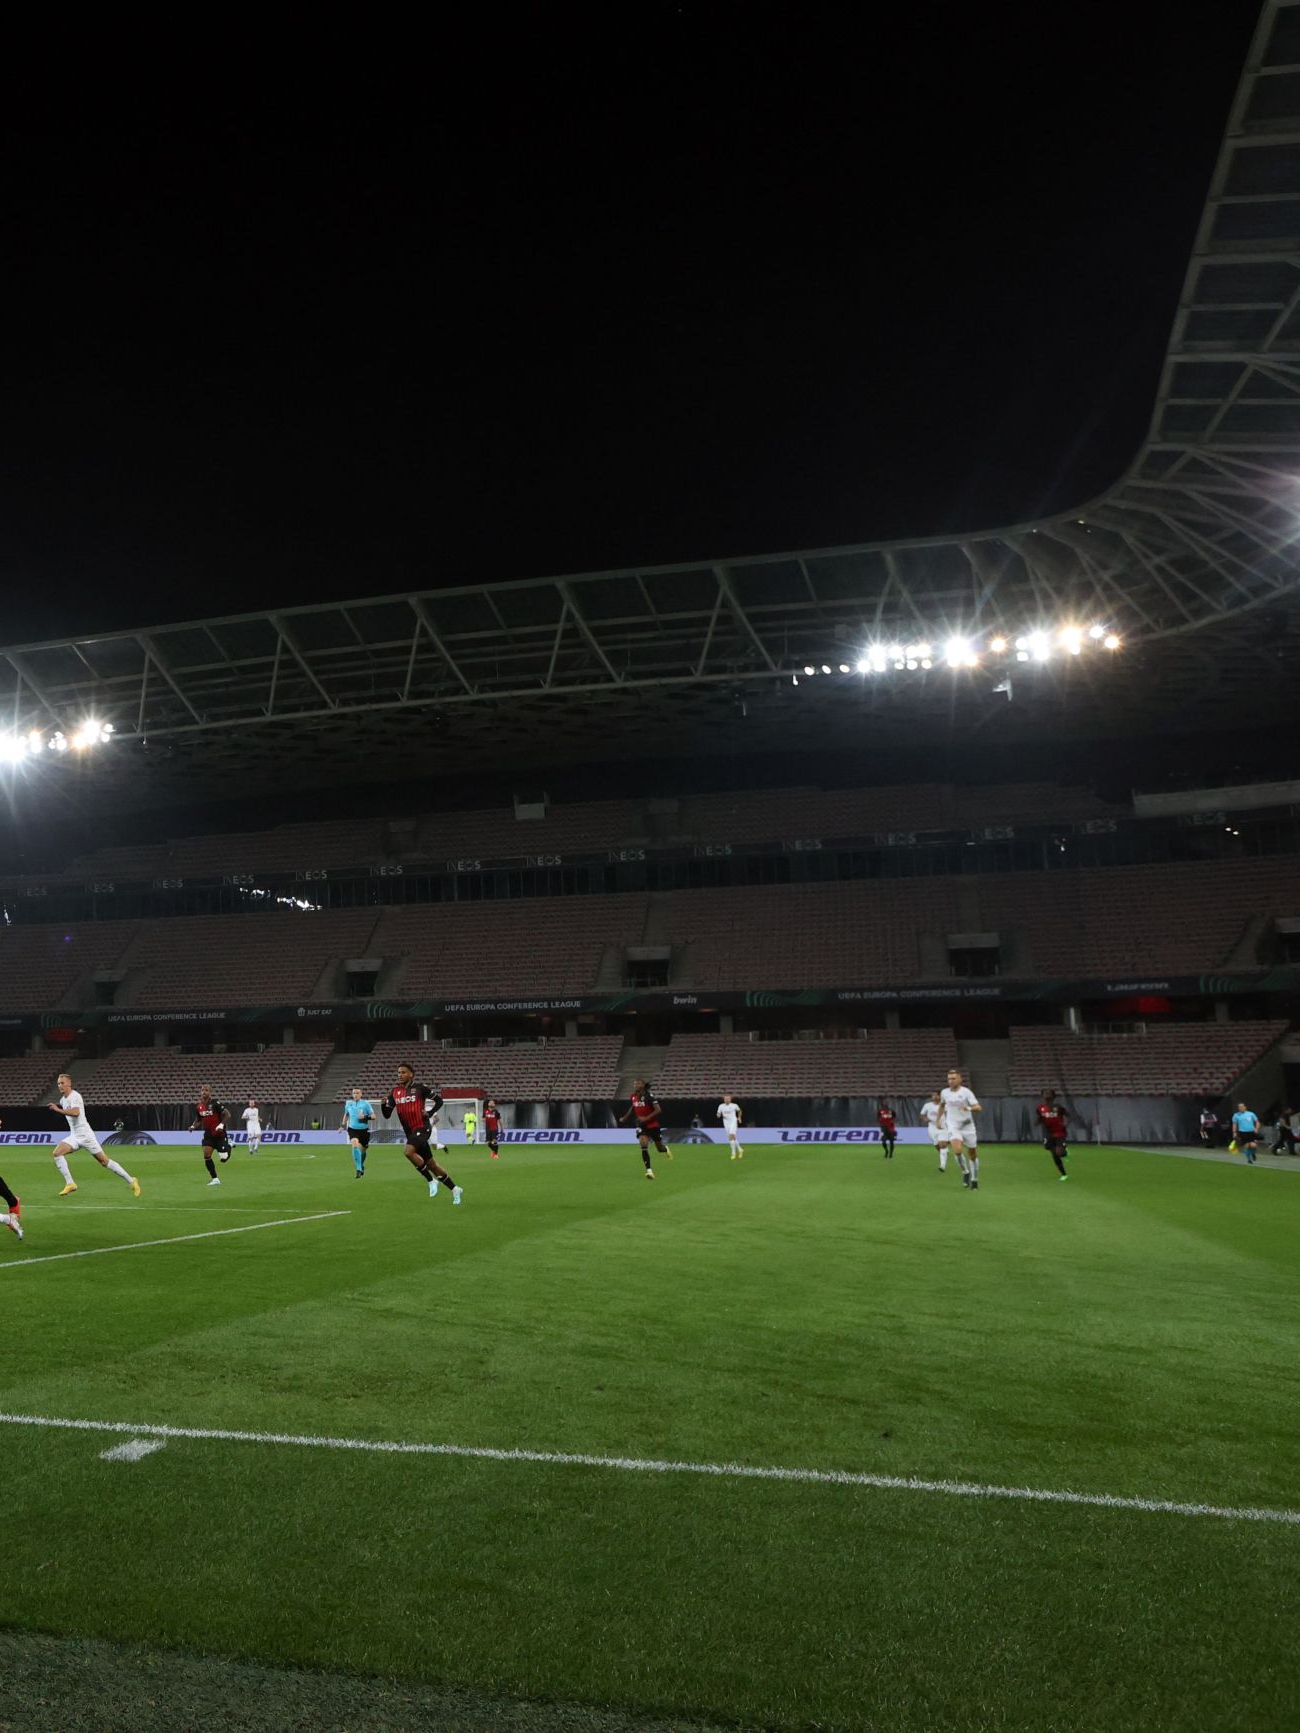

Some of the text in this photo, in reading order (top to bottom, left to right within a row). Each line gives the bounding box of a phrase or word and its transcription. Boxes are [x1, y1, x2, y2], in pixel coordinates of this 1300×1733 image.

[837, 987, 1000, 1000] UEFA EUROPA CONFERENCE LEAGUE
[467, 1003, 496, 1011] EUROPA
[497, 1001, 548, 1010] CONFERENCE
[551, 1000, 581, 1008] LEAGUE
[673, 995, 698, 1005] bwin
[107, 1014, 125, 1022] UEFA
[153, 1012, 197, 1021] CONFERENCE
[199, 1011, 226, 1019] LEAGUE
[497, 1131, 585, 1143] aufenn
